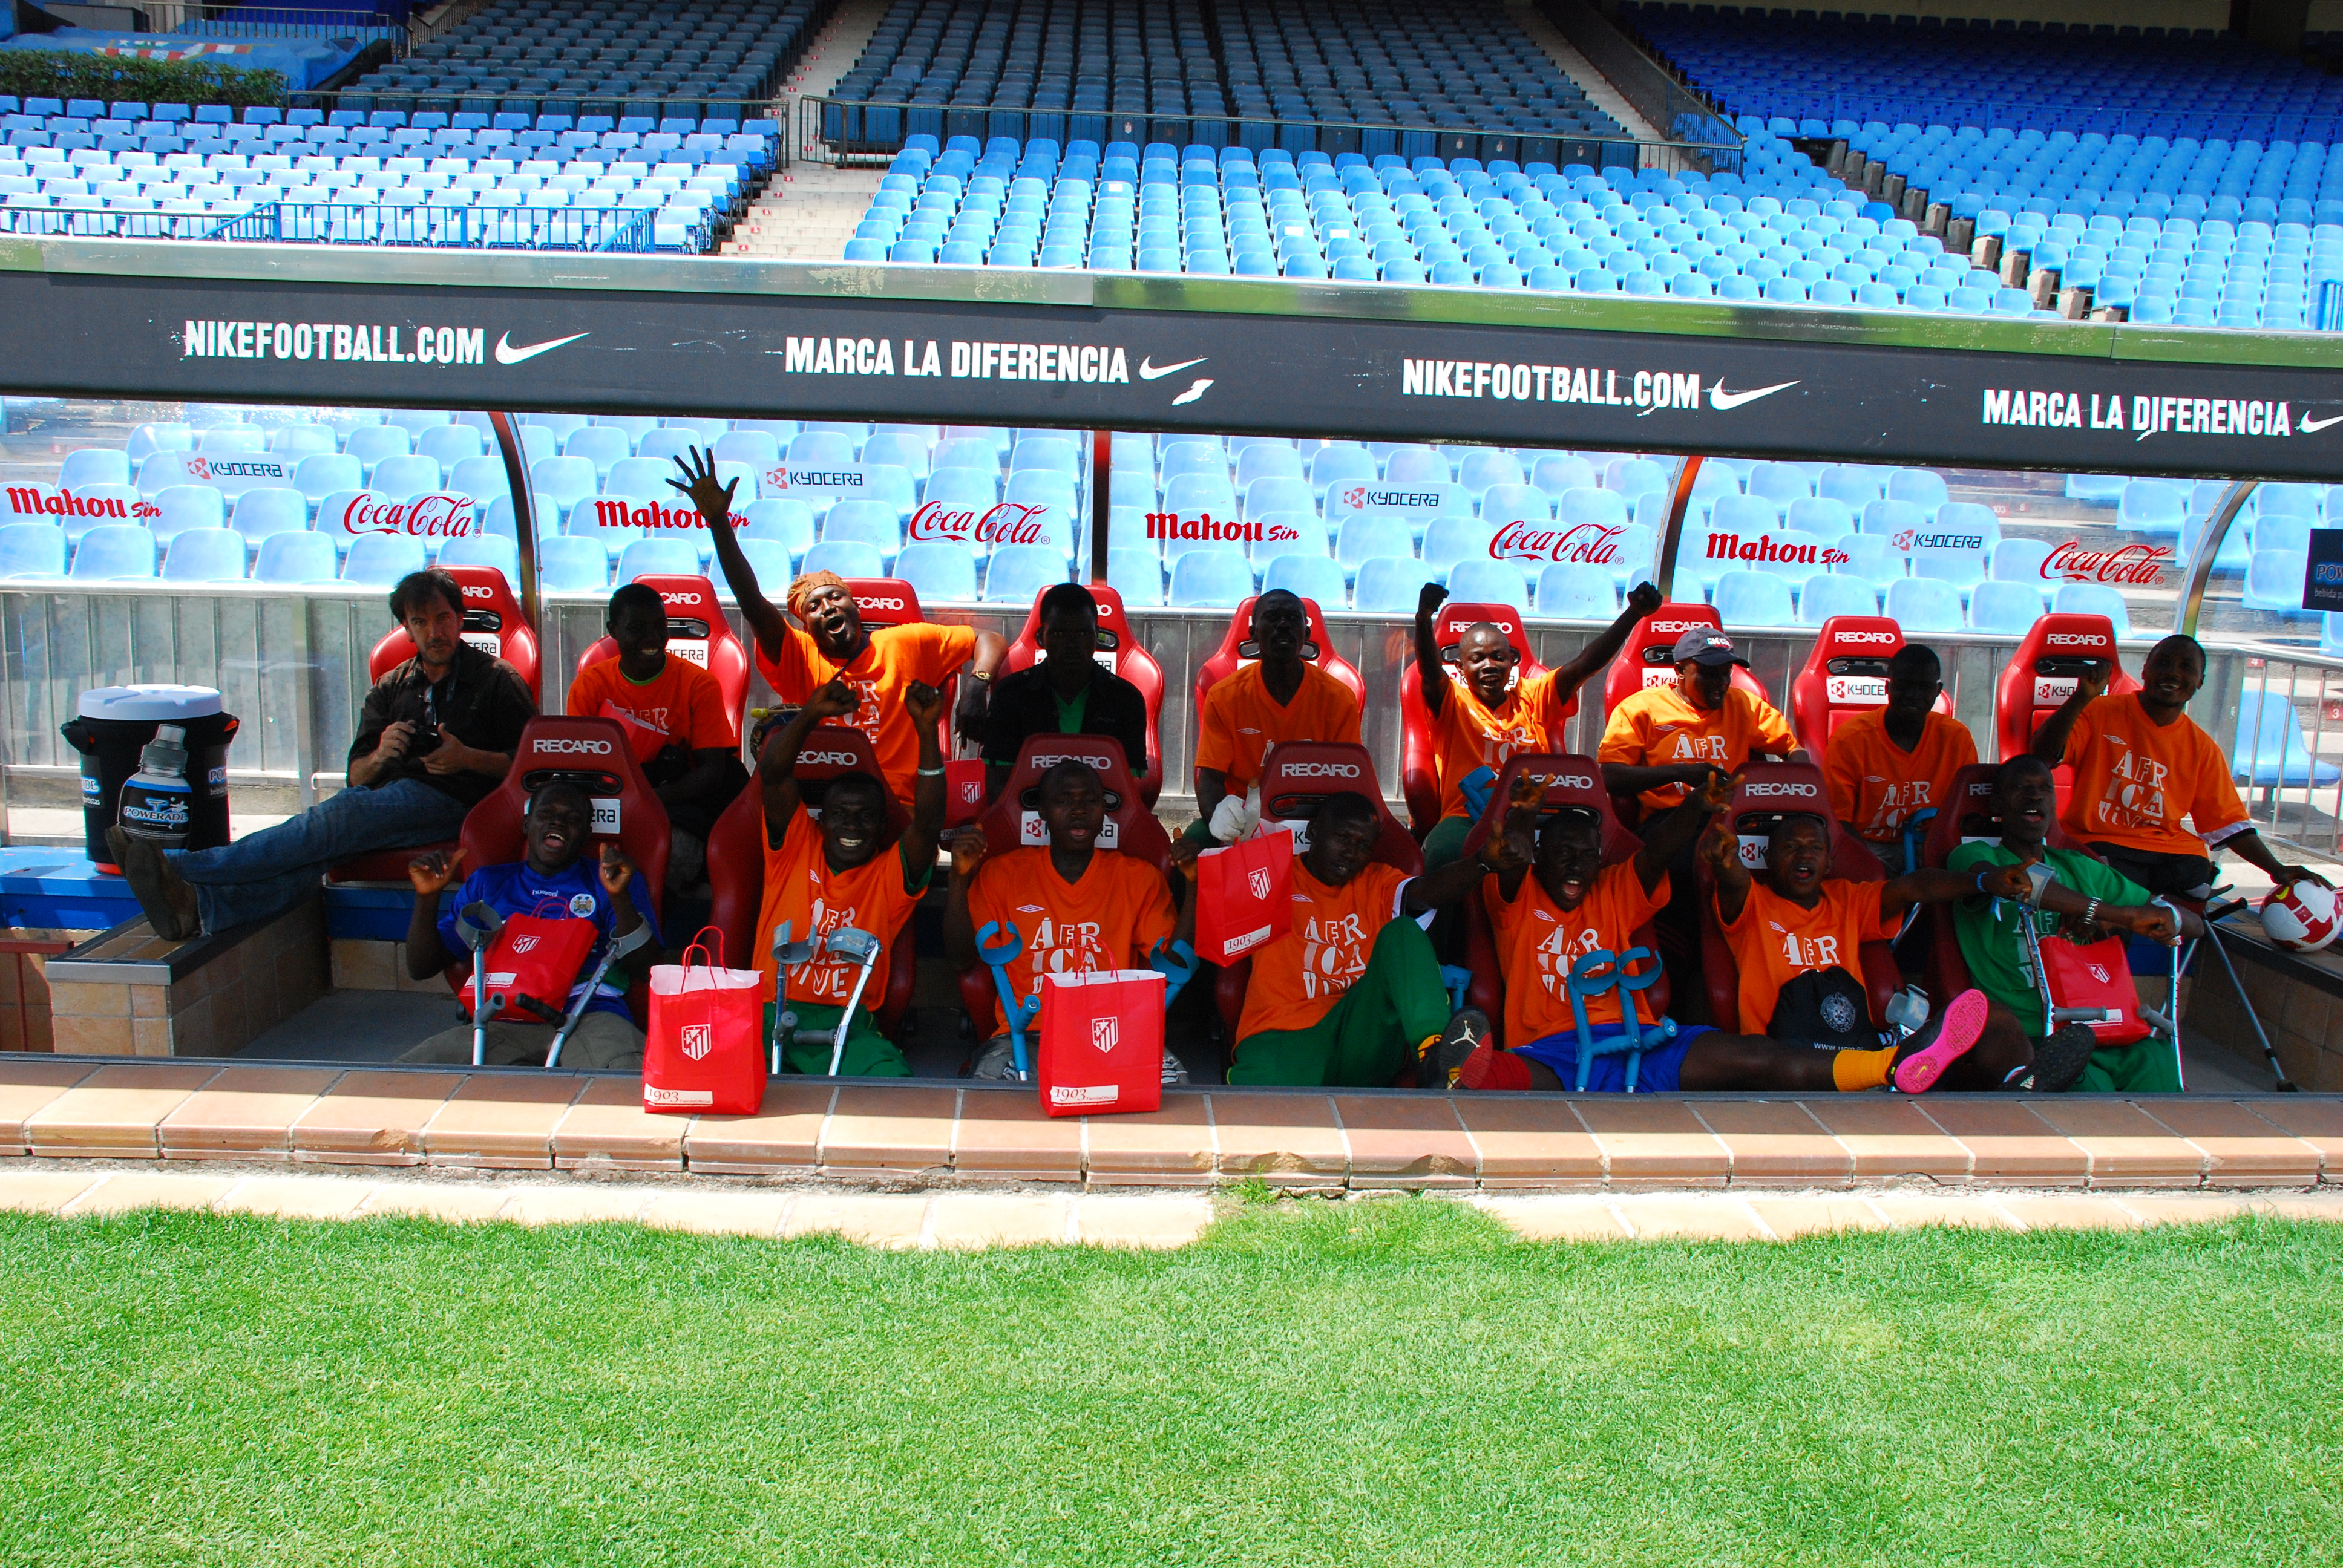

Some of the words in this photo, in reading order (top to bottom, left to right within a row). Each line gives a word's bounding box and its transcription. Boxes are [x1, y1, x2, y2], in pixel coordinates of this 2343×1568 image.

[185, 320, 484, 364] NIKEFOOTBALL.COM
[786, 337, 894, 376] MARCA
[904, 339, 942, 377] LA
[951, 342, 1129, 384] DIFERENCIA
[1403, 359, 1700, 410] NIKEFOOTBALL.COM
[1983, 389, 2082, 428] MARCA
[2090, 394, 2124, 430] LA
[2132, 396, 2291, 436] DIFERENCIA
[210, 462, 283, 477] KYOCERA
[790, 470, 863, 486] KYOCERA
[5, 487, 127, 518] Mahou
[1366, 491, 1439, 508] KYOCERA
[1144, 512, 1262, 541] Mahou
[1706, 533, 1817, 564] Mahou
[1914, 533, 1982, 549] KYOCERA
[462, 587, 493, 598] ARO
[660, 593, 701, 604] CARO
[853, 596, 904, 610] ECARO
[1835, 632, 1895, 644] RECARO
[2047, 634, 2107, 646] RECARO
[2333, 708, 2339, 719] 3
[533, 739, 612, 754] RECARO
[795, 751, 857, 766] ECARO
[1282, 763, 1360, 778] RECARO
[1745, 783, 1817, 797] RECARO
[125, 807, 188, 821] POWERADE
[1228, 935, 1251, 950] 1903
[650, 1089, 678, 1102] 1903
[1055, 1089, 1086, 1101] 1903
